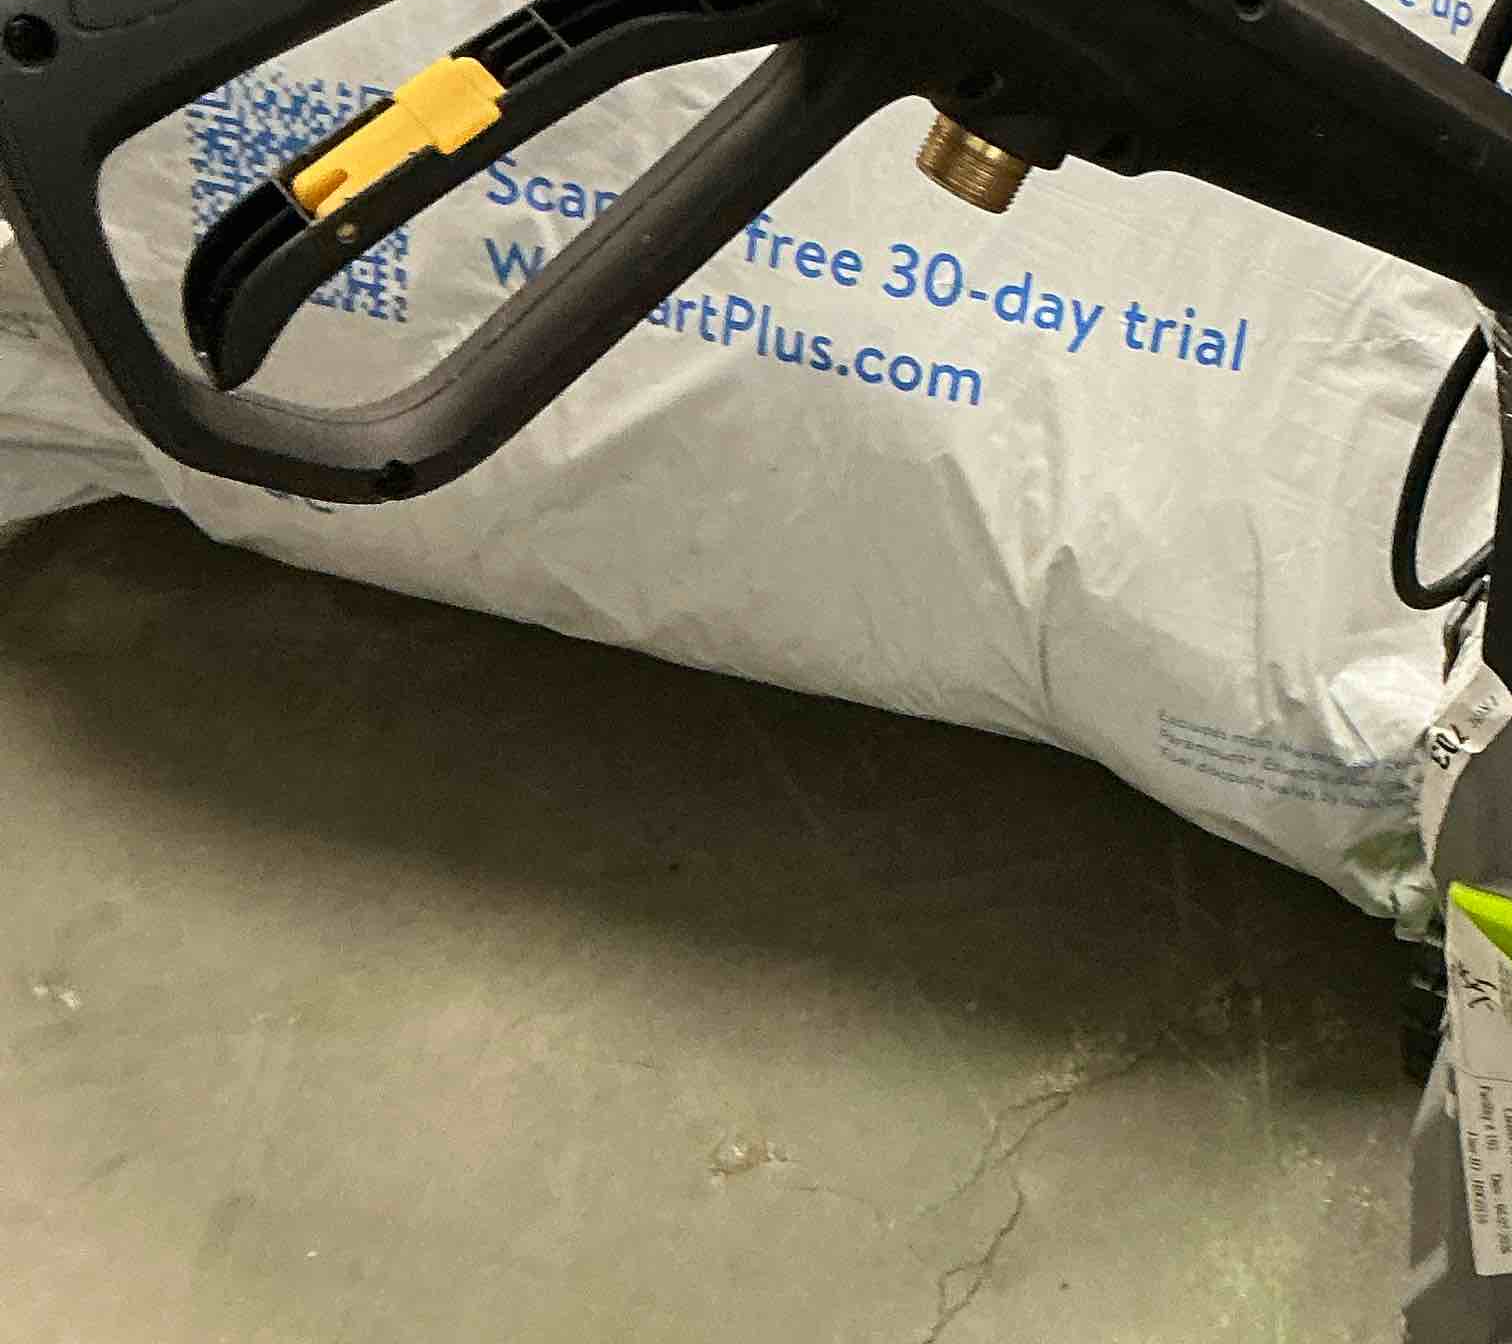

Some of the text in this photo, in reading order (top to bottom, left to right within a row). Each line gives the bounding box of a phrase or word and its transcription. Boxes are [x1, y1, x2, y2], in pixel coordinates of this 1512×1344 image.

[743, 212, 862, 287] free
[883, 243, 1104, 354] 30-day
[1122, 301, 1248, 371] trial
